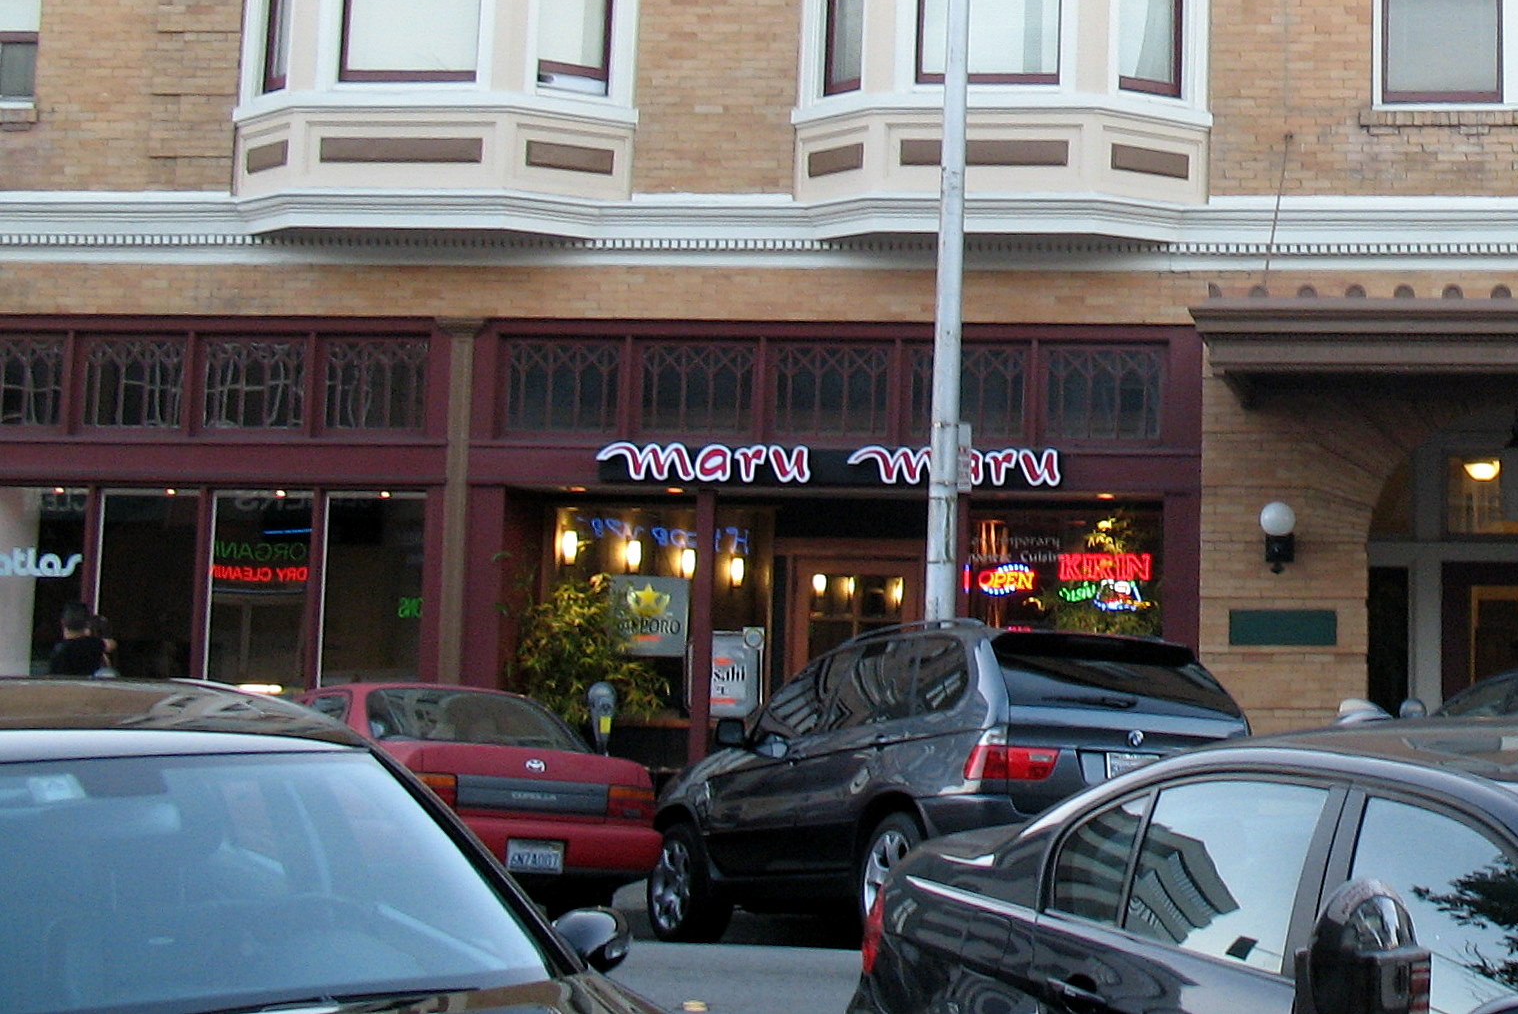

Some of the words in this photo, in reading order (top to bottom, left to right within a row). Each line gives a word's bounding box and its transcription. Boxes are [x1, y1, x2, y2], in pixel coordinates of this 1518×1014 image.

[1058, 553, 1152, 581] KIRIN
[977, 569, 1036, 591] OPEN
[713, 665, 746, 682] sahi
